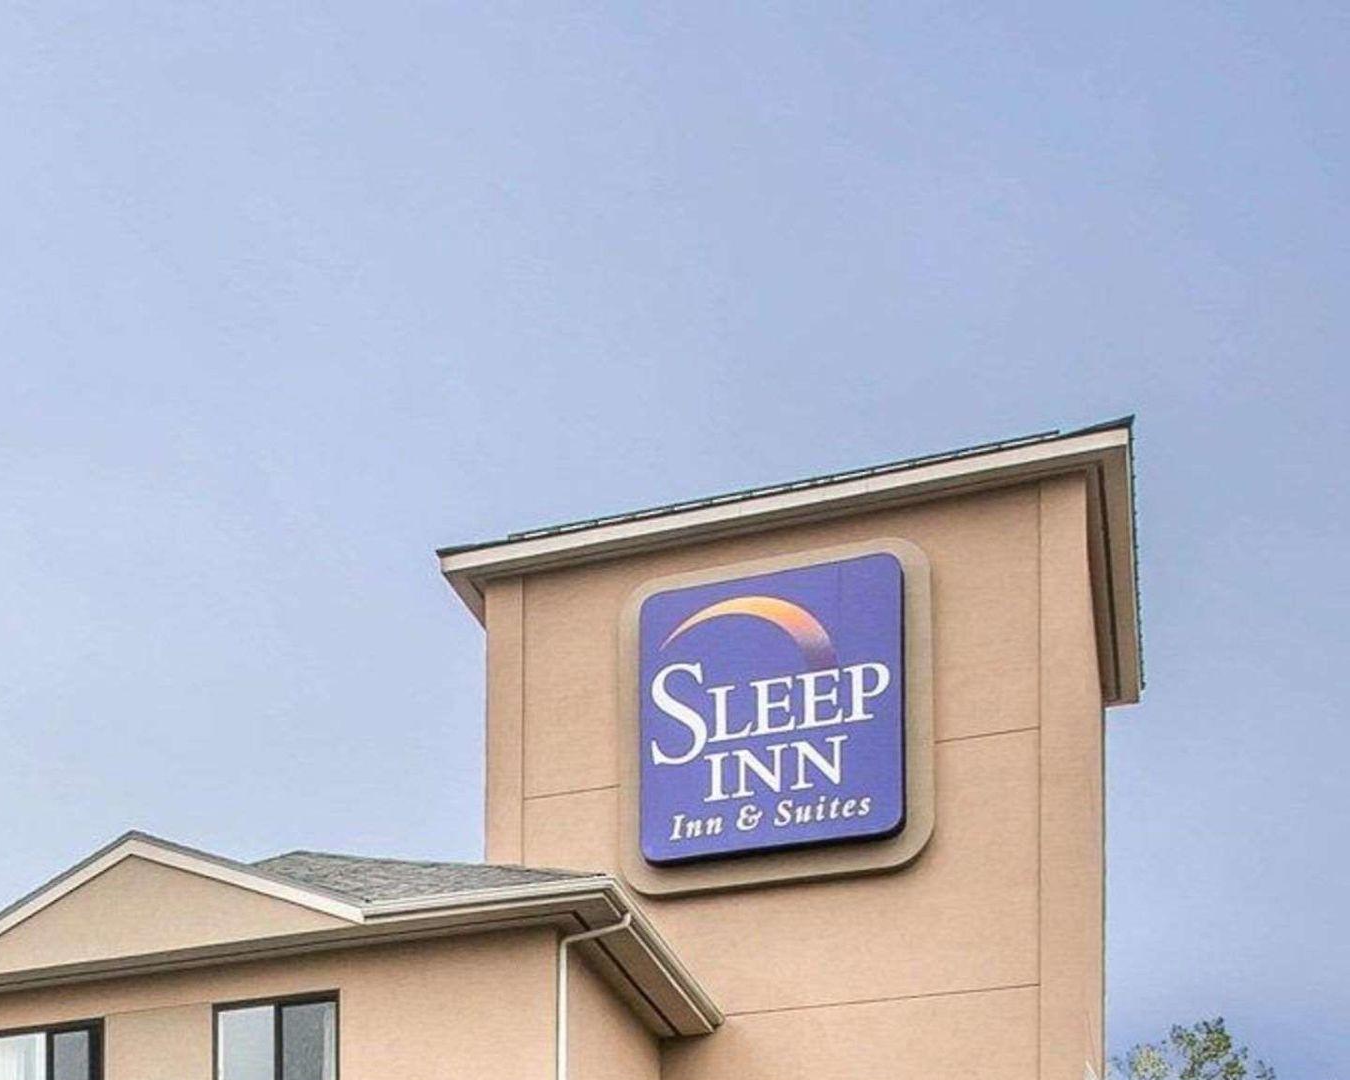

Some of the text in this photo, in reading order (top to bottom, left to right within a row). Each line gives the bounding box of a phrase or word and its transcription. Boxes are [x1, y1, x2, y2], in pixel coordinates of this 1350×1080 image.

[651, 662, 891, 766] SLEEP
[703, 735, 848, 802] INN
[669, 797, 872, 841] Inn & Suites
